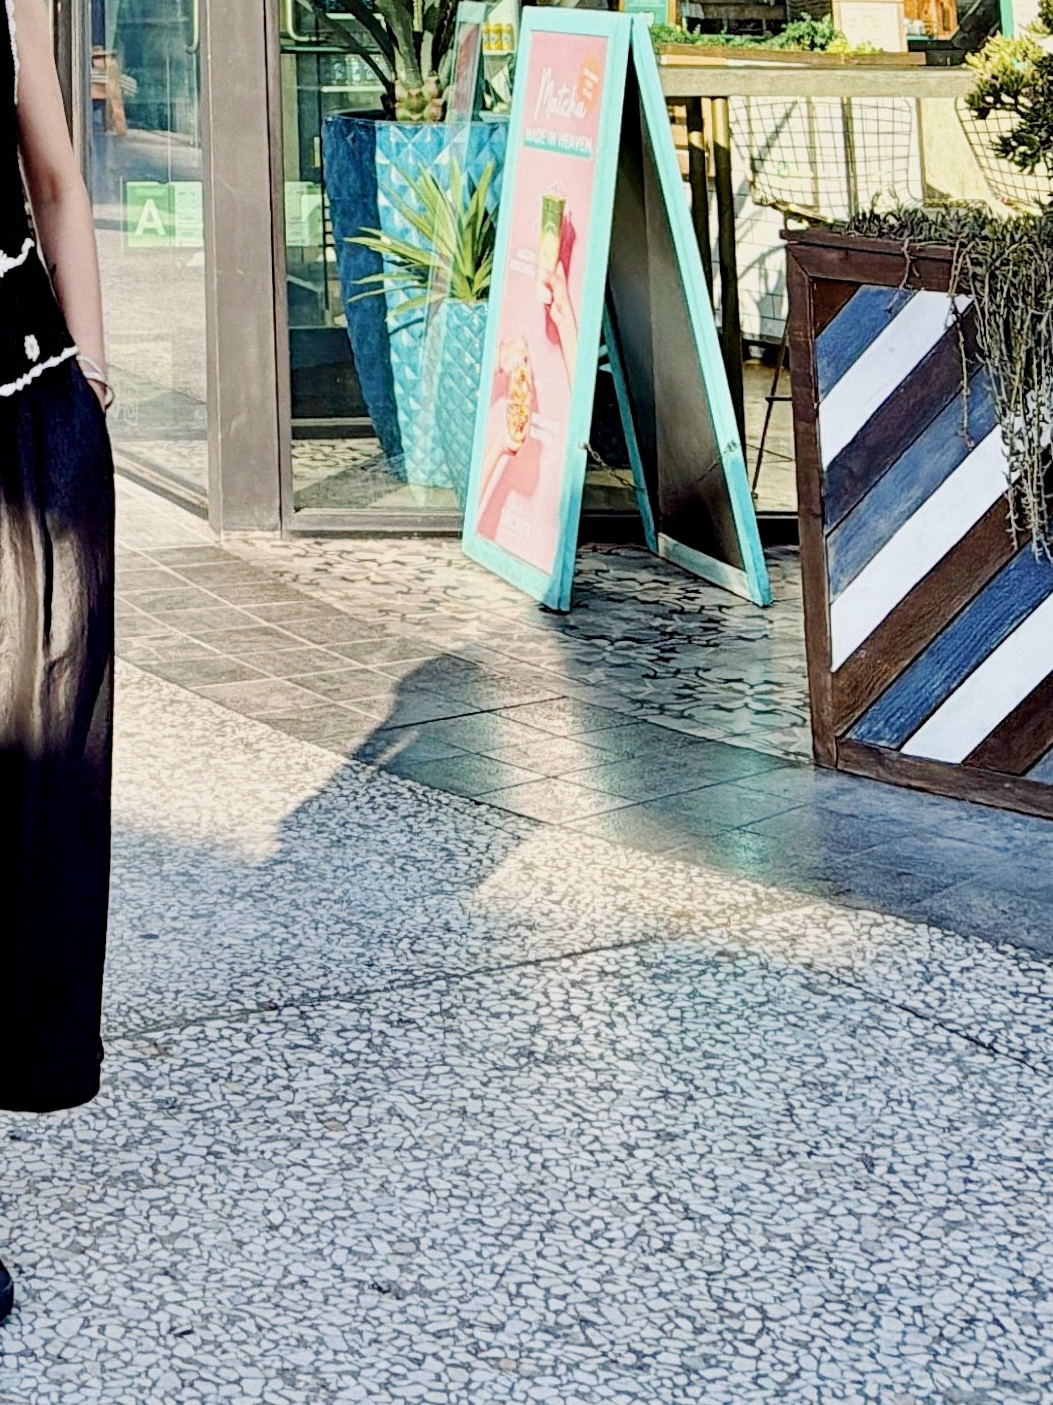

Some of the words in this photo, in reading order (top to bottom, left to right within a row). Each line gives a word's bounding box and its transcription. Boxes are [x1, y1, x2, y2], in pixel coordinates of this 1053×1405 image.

[533, 67, 588, 121] Matcha
[557, 130, 593, 155] HEAVEN
[134, 198, 166, 237] A
